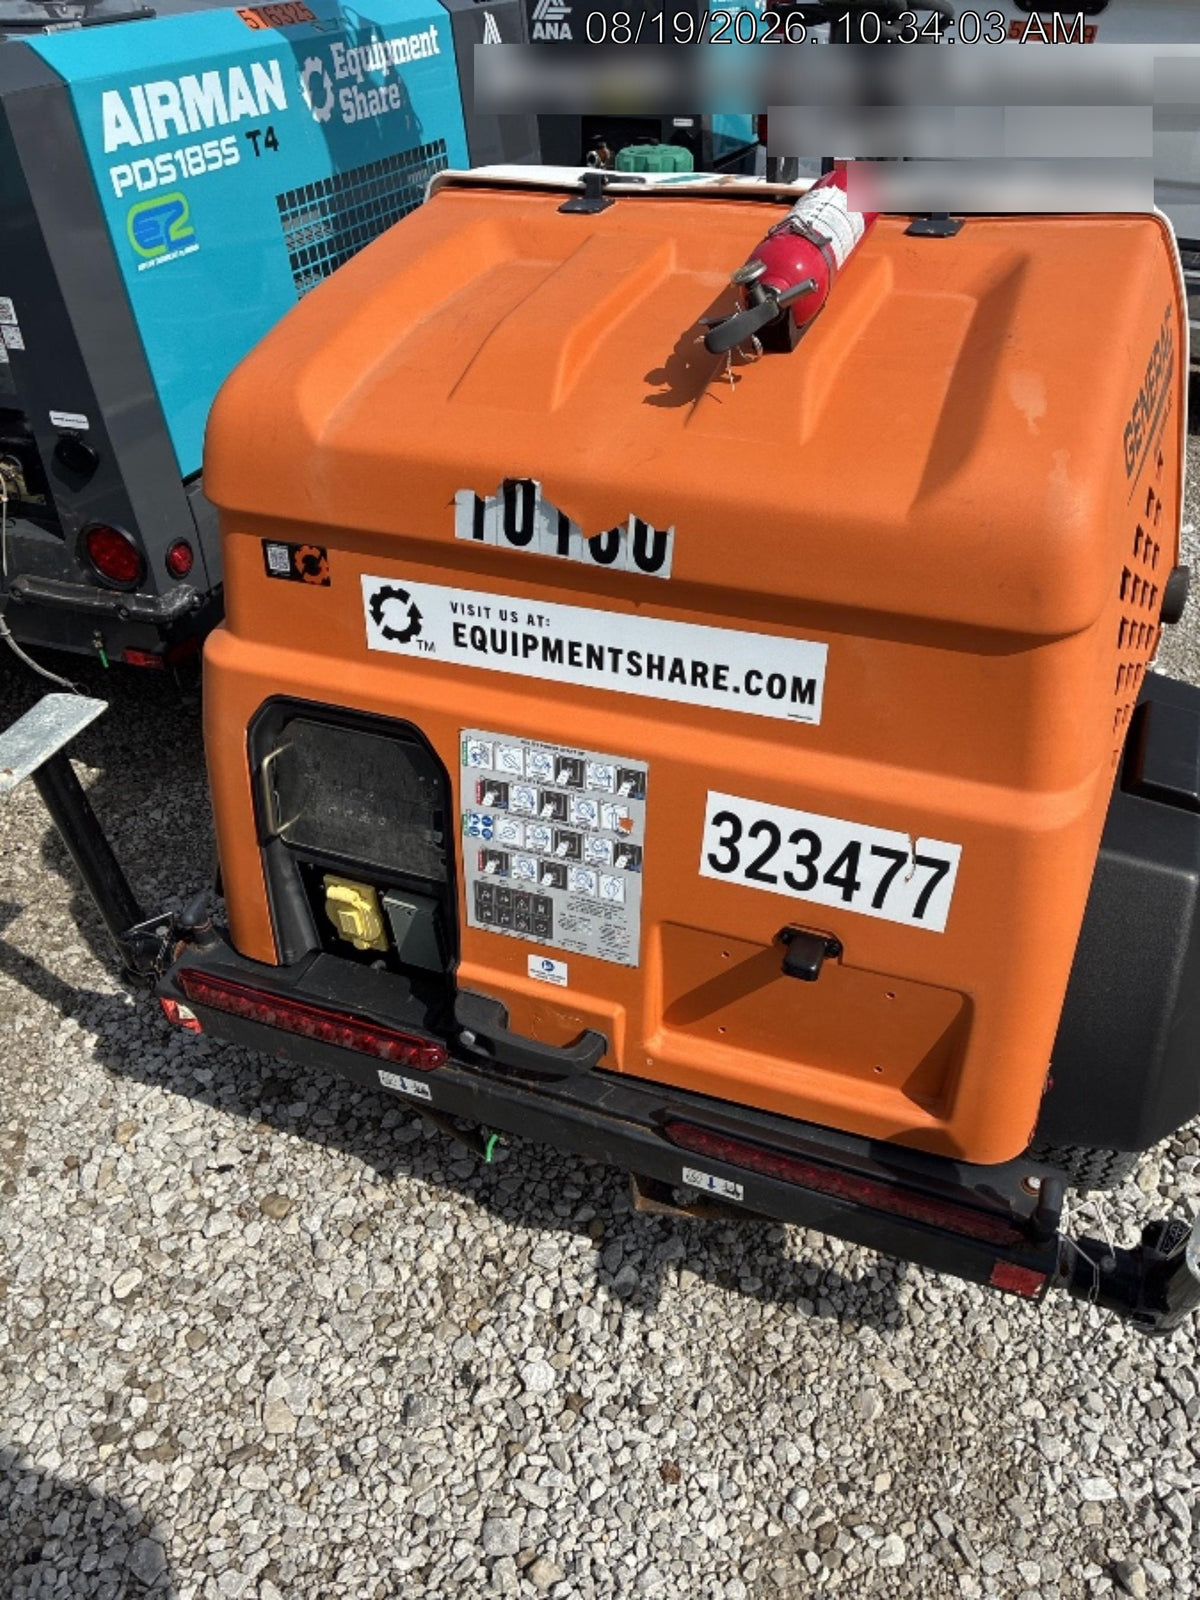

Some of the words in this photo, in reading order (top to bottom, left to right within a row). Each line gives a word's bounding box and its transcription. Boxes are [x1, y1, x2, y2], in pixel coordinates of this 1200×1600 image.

[329, 24, 441, 84] Equipment
[532, 22, 573, 40] ANA
[102, 60, 288, 153] AIRMAN
[339, 83, 401, 124] Share
[245, 126, 279, 158] T4
[450, 601, 491, 619] VISIT
[499, 609, 519, 624] US
[527, 614, 551, 628] AT:
[452, 621, 817, 705] EQUIPMENTSHARE.COM
[707, 810, 951, 919] 323477
